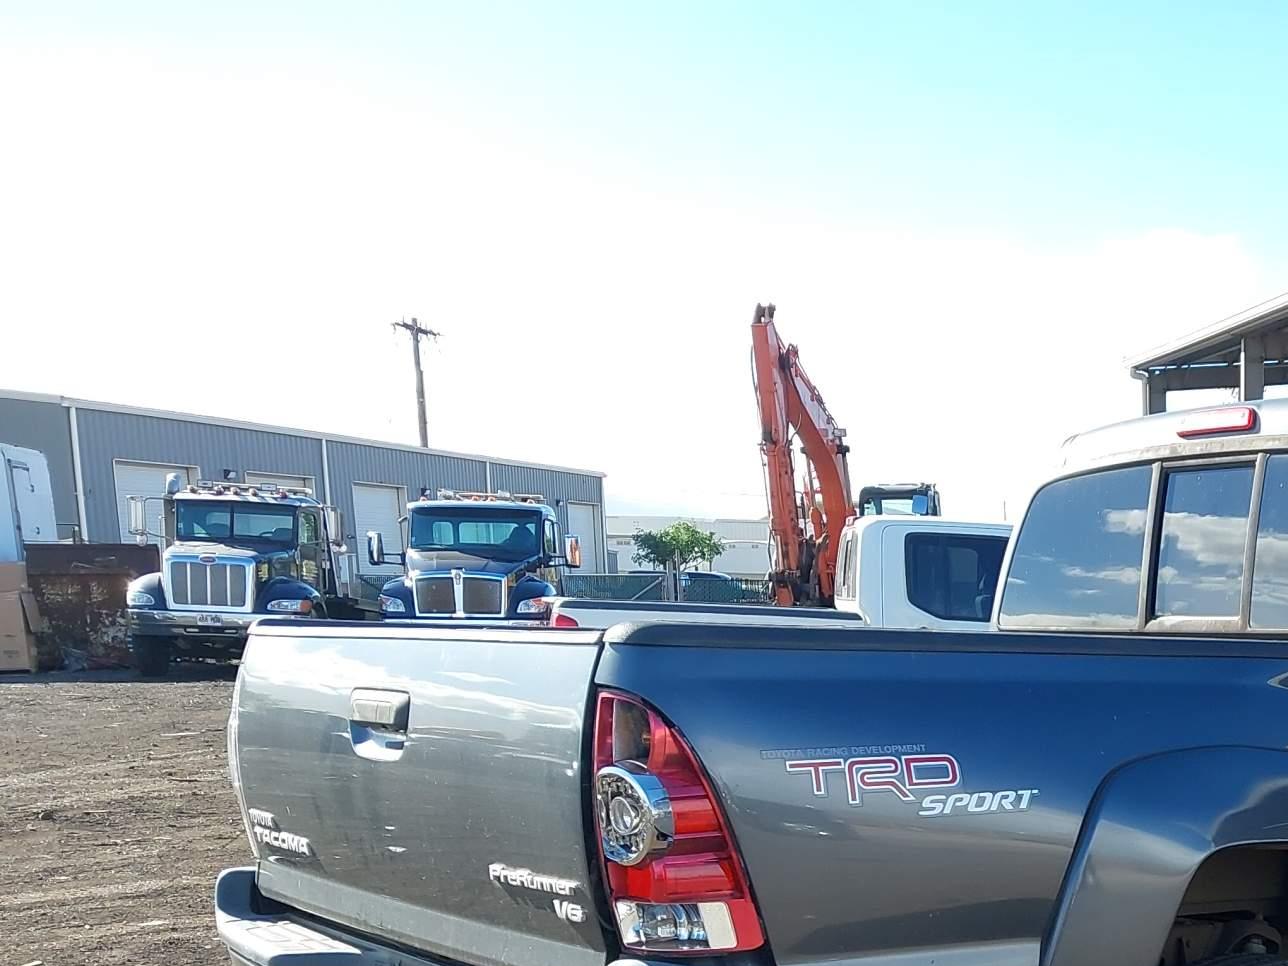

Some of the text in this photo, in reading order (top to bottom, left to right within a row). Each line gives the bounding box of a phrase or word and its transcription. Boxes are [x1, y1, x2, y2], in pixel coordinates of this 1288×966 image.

[807, 746, 848, 758] RACING
[851, 743, 927, 755] DEVELOPMENT
[785, 754, 960, 804] TRD
[918, 789, 1038, 816] SPORT
[253, 825, 310, 856] TACOMA
[488, 862, 581, 896] PreRunner
[552, 899, 584, 922] V6
